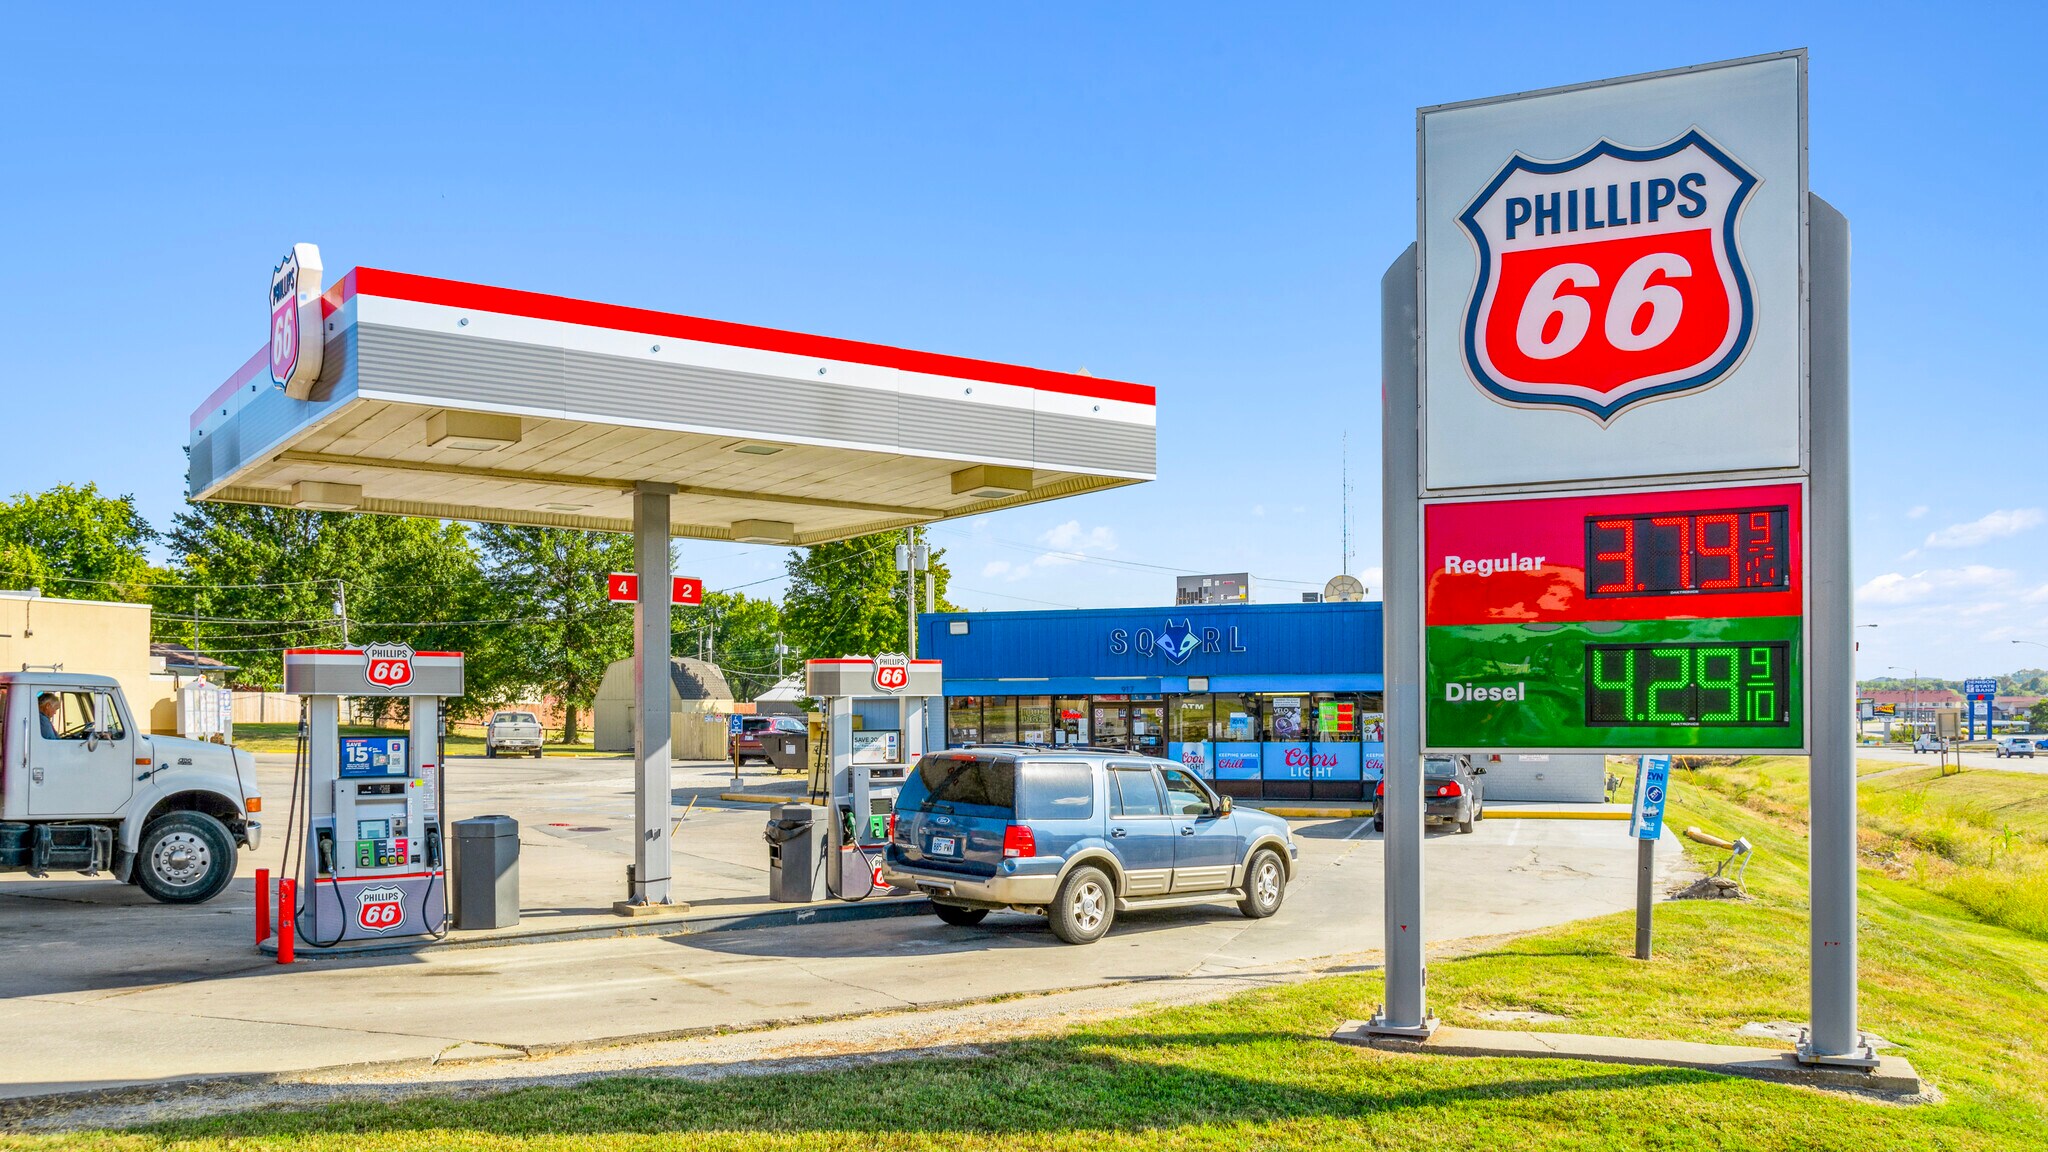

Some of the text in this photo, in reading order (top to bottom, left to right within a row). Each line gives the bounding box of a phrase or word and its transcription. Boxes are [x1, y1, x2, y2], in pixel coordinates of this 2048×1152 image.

[1505, 172, 1708, 240] PHILLIPS
[272, 266, 295, 306] PHILLIPS
[1515, 252, 1693, 361] 66
[274, 308, 293, 366] 66
[1596, 513, 1739, 593] 3.79
[1444, 552, 1546, 578] Regular
[617, 580, 628, 595] 4
[682, 583, 693, 598] 2
[372, 649, 408, 658] PHILLIPS
[879, 658, 905, 666] PHILLIPS
[373, 662, 405, 680] 66
[881, 668, 904, 684] 66
[1445, 681, 1525, 702] Diesel
[1593, 648, 1739, 722] 4.29
[1874, 705, 1894, 713] SONIC
[1218, 759, 1244, 769] Chill
[1284, 747, 1339, 767] Coors
[1290, 767, 1333, 777] LIGHT
[1647, 771, 1664, 782] ZYN
[409, 781, 415, 789] 4
[363, 891, 399, 902] PHILLIPS
[365, 904, 397, 924] 66
